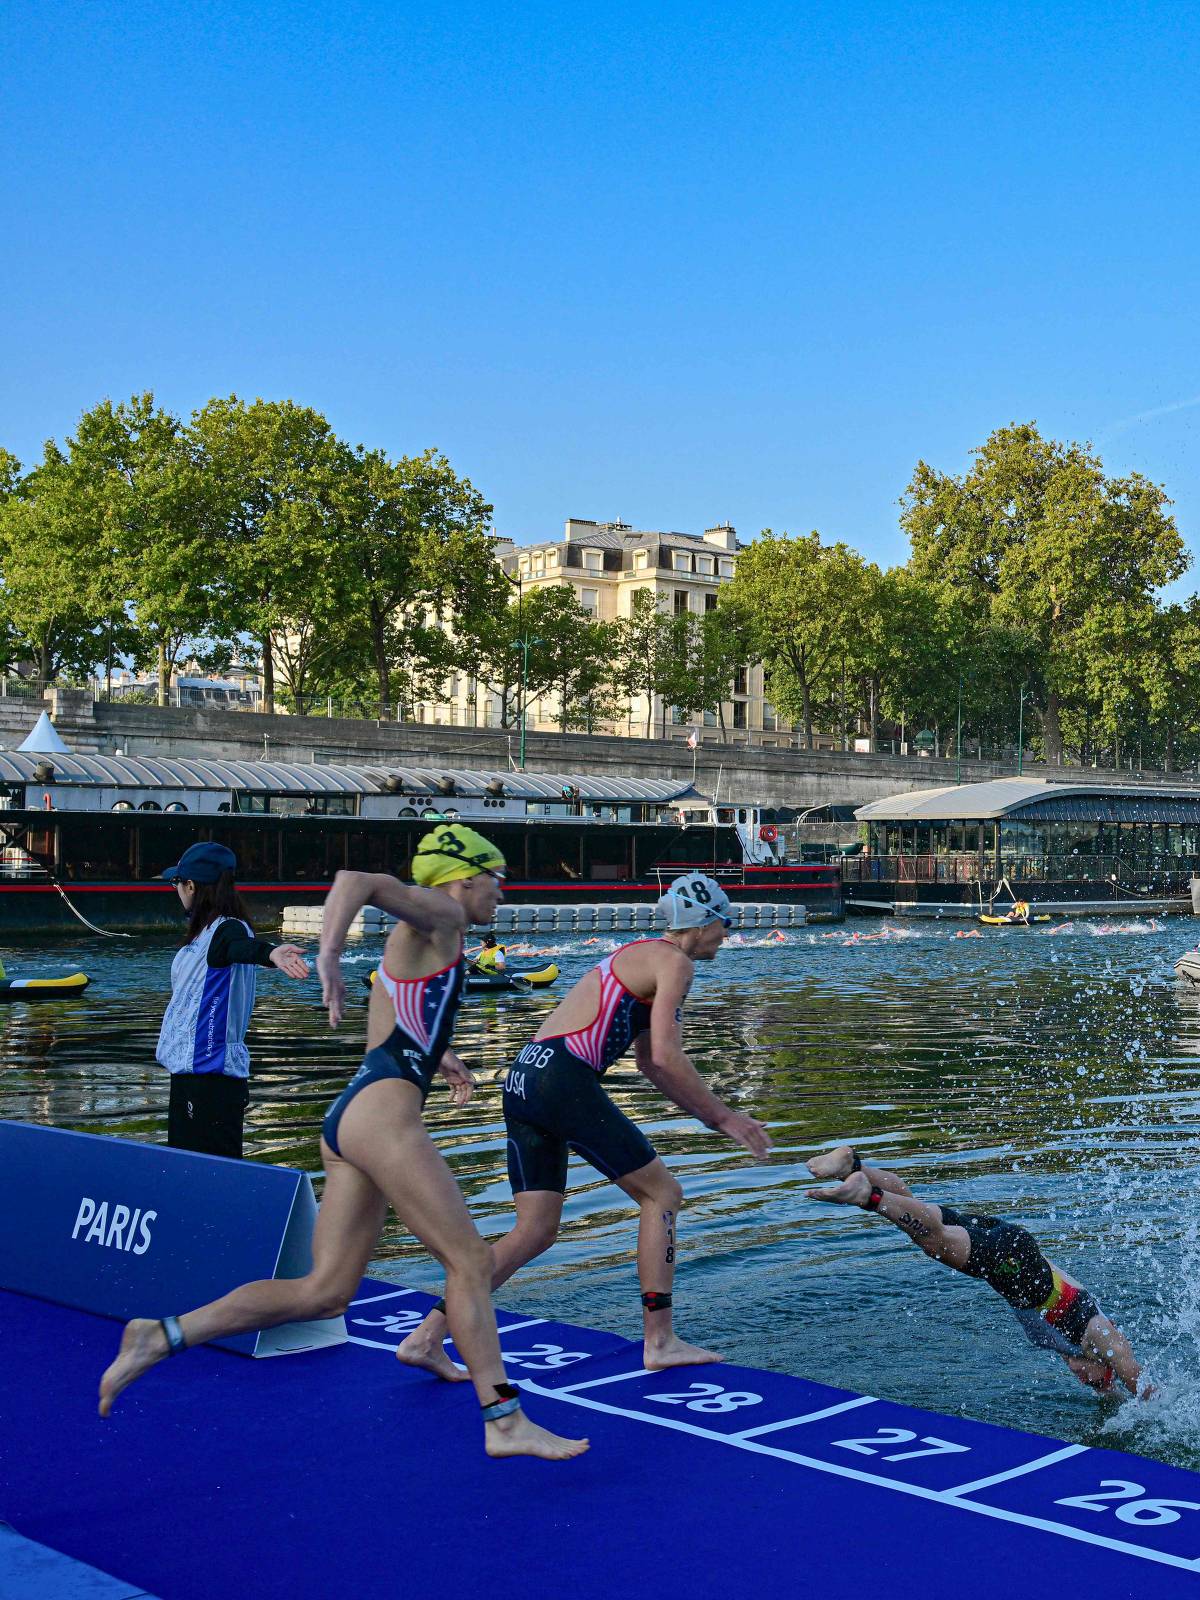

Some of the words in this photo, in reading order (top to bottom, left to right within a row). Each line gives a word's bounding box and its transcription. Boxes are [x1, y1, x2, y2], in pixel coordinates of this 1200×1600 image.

[438, 831, 466, 856] 3
[677, 880, 712, 908] 18
[504, 1070, 526, 1100] USA
[71, 1197, 158, 1255] PARIS
[351, 1310, 424, 1334] 30
[501, 1344, 592, 1370] 29
[643, 1383, 763, 1413] 28
[830, 1428, 972, 1462] 27
